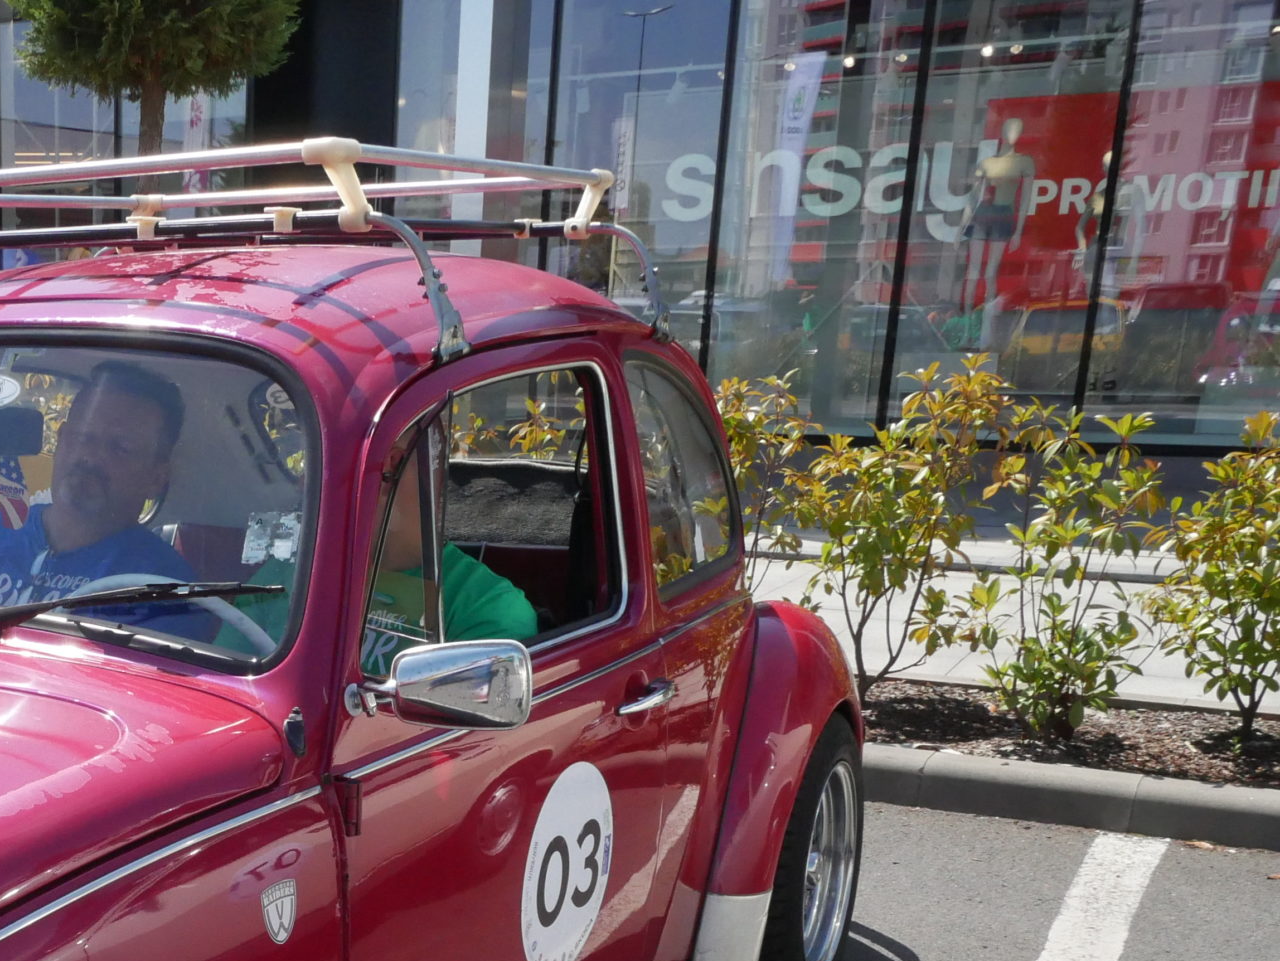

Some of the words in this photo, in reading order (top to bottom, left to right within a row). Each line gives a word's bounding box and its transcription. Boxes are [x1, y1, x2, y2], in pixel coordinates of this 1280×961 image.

[661, 138, 1000, 243] snsay
[1027, 169, 1280, 221] PRMOȚII
[536, 818, 602, 928] 03
